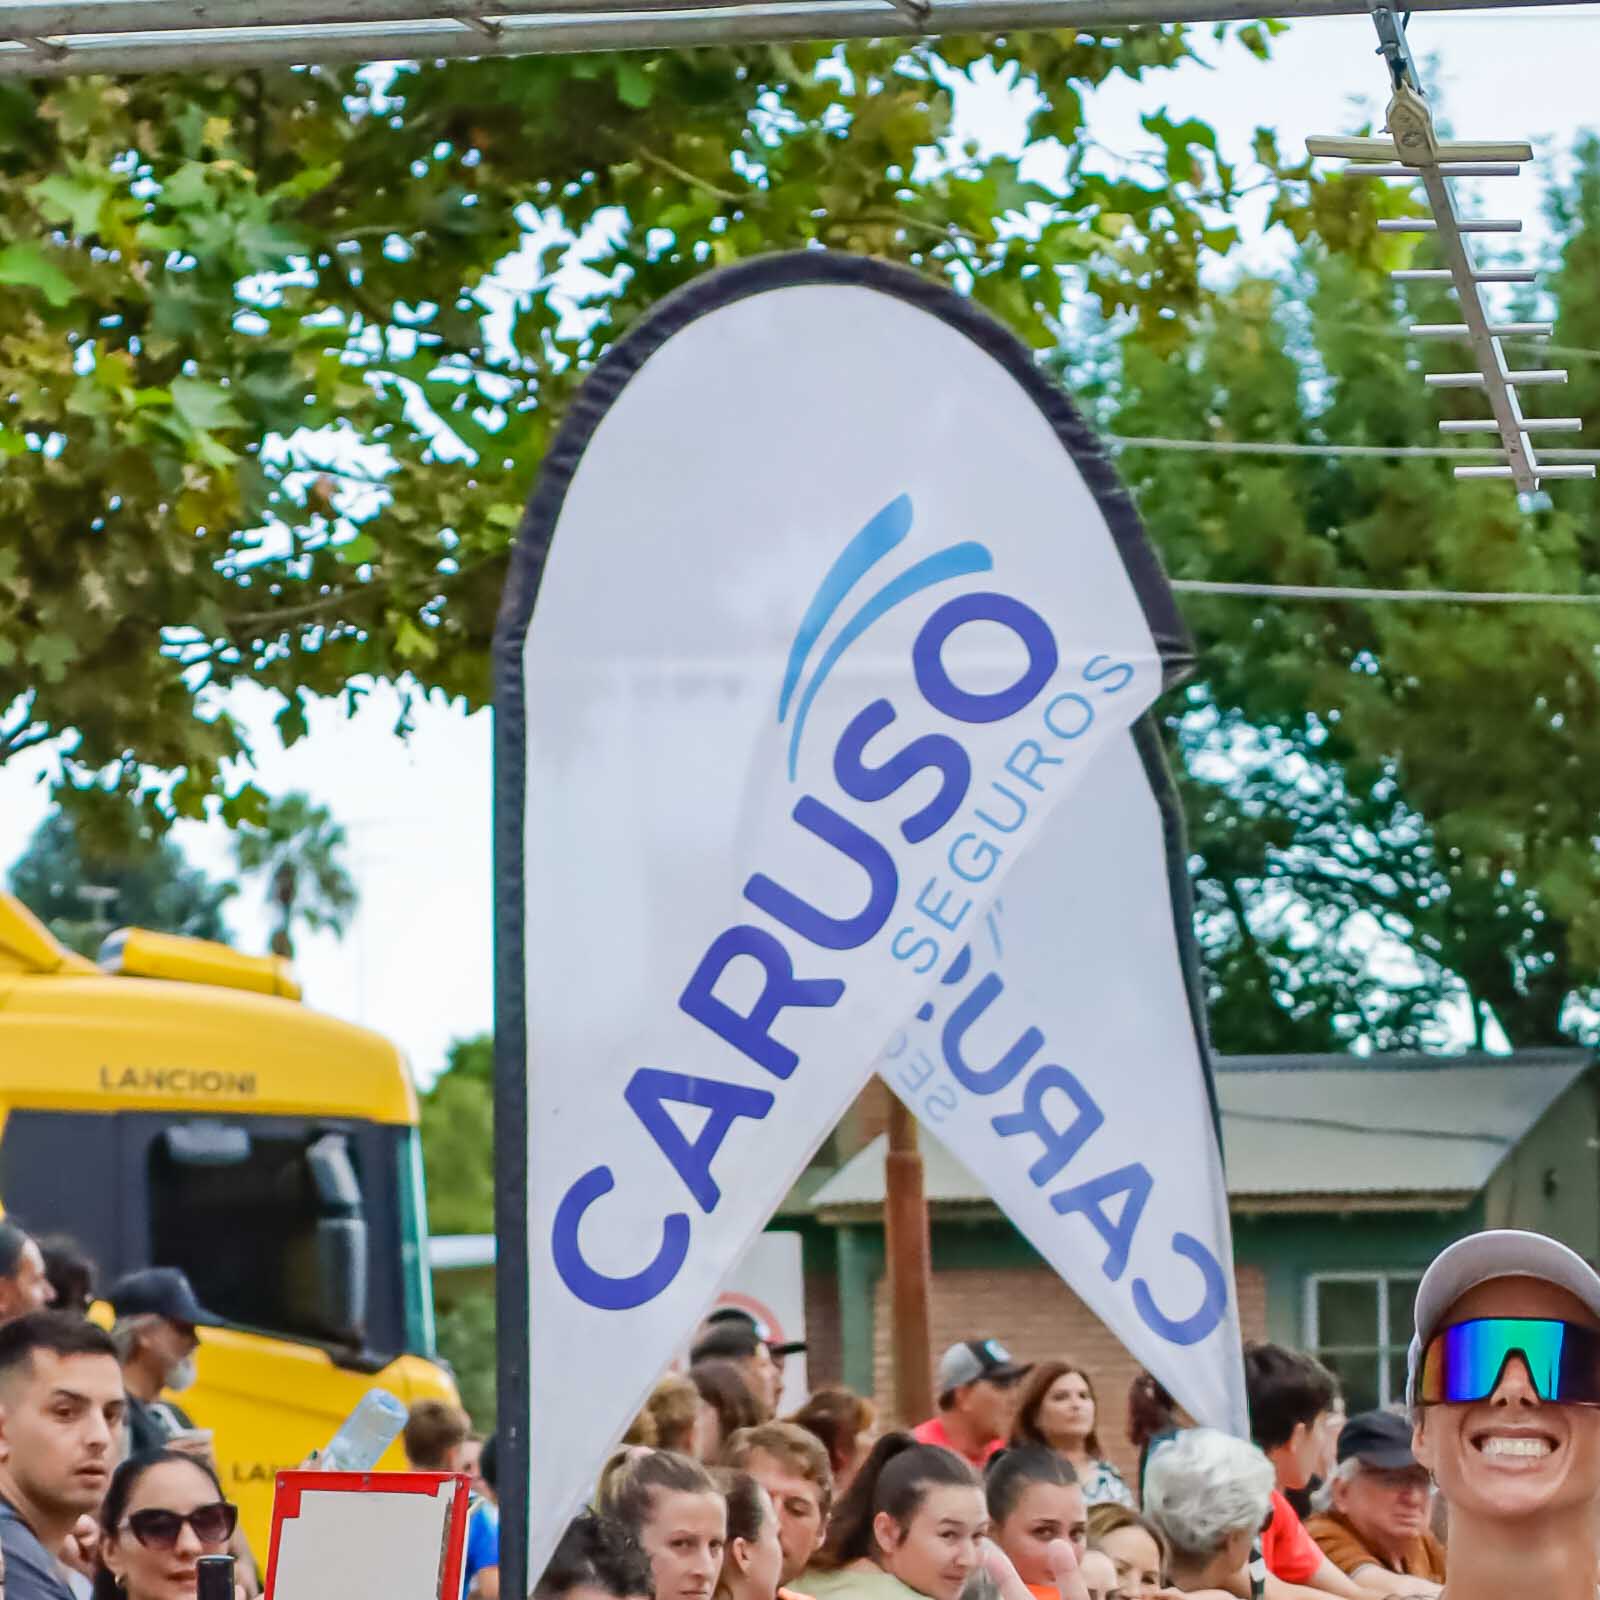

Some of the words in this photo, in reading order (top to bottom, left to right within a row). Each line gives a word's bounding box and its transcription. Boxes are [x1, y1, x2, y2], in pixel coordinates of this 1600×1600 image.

[552, 592, 1058, 1310] CARUSO
[890, 652, 1134, 975] SEGUROS
[99, 1064, 257, 1094] LANCIONI
